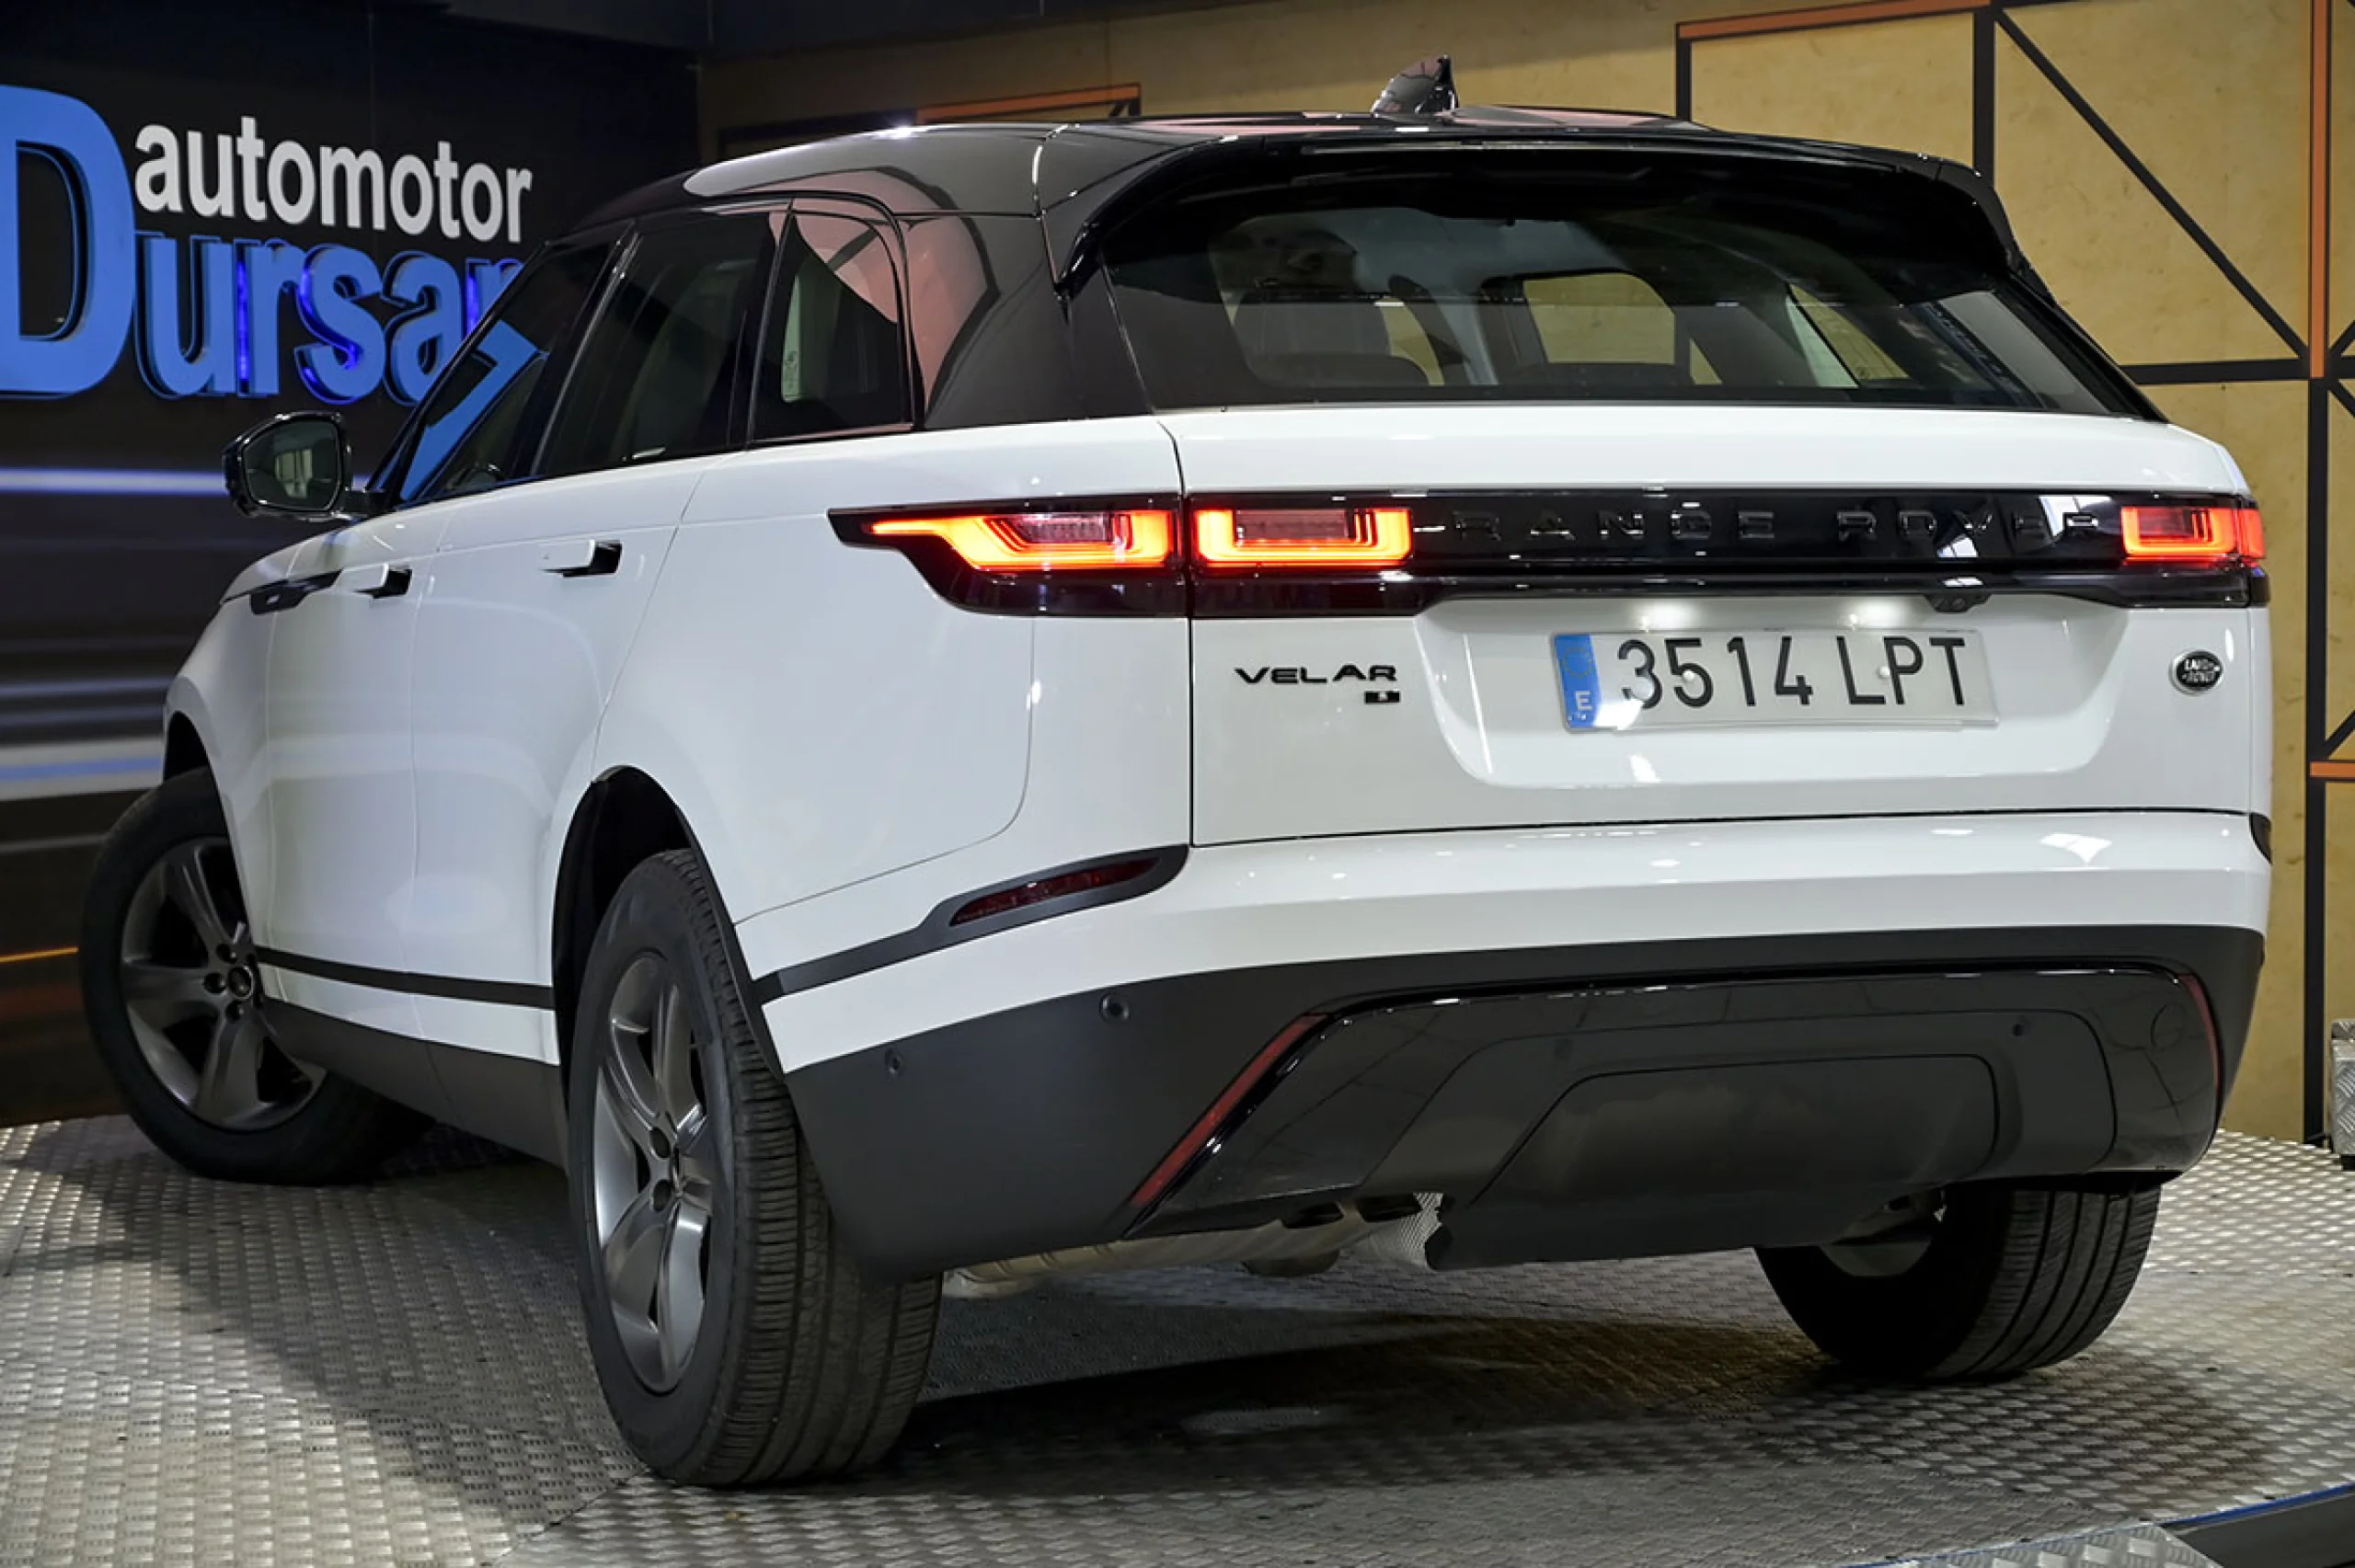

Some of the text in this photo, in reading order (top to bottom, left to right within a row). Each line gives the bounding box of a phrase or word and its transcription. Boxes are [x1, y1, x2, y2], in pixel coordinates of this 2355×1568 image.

[134, 117, 532, 243] automotor
[1453, 510, 1775, 541] RANGE
[1235, 664, 1398, 684] VELAR
[1575, 635, 1966, 712] E 3514 LPT
